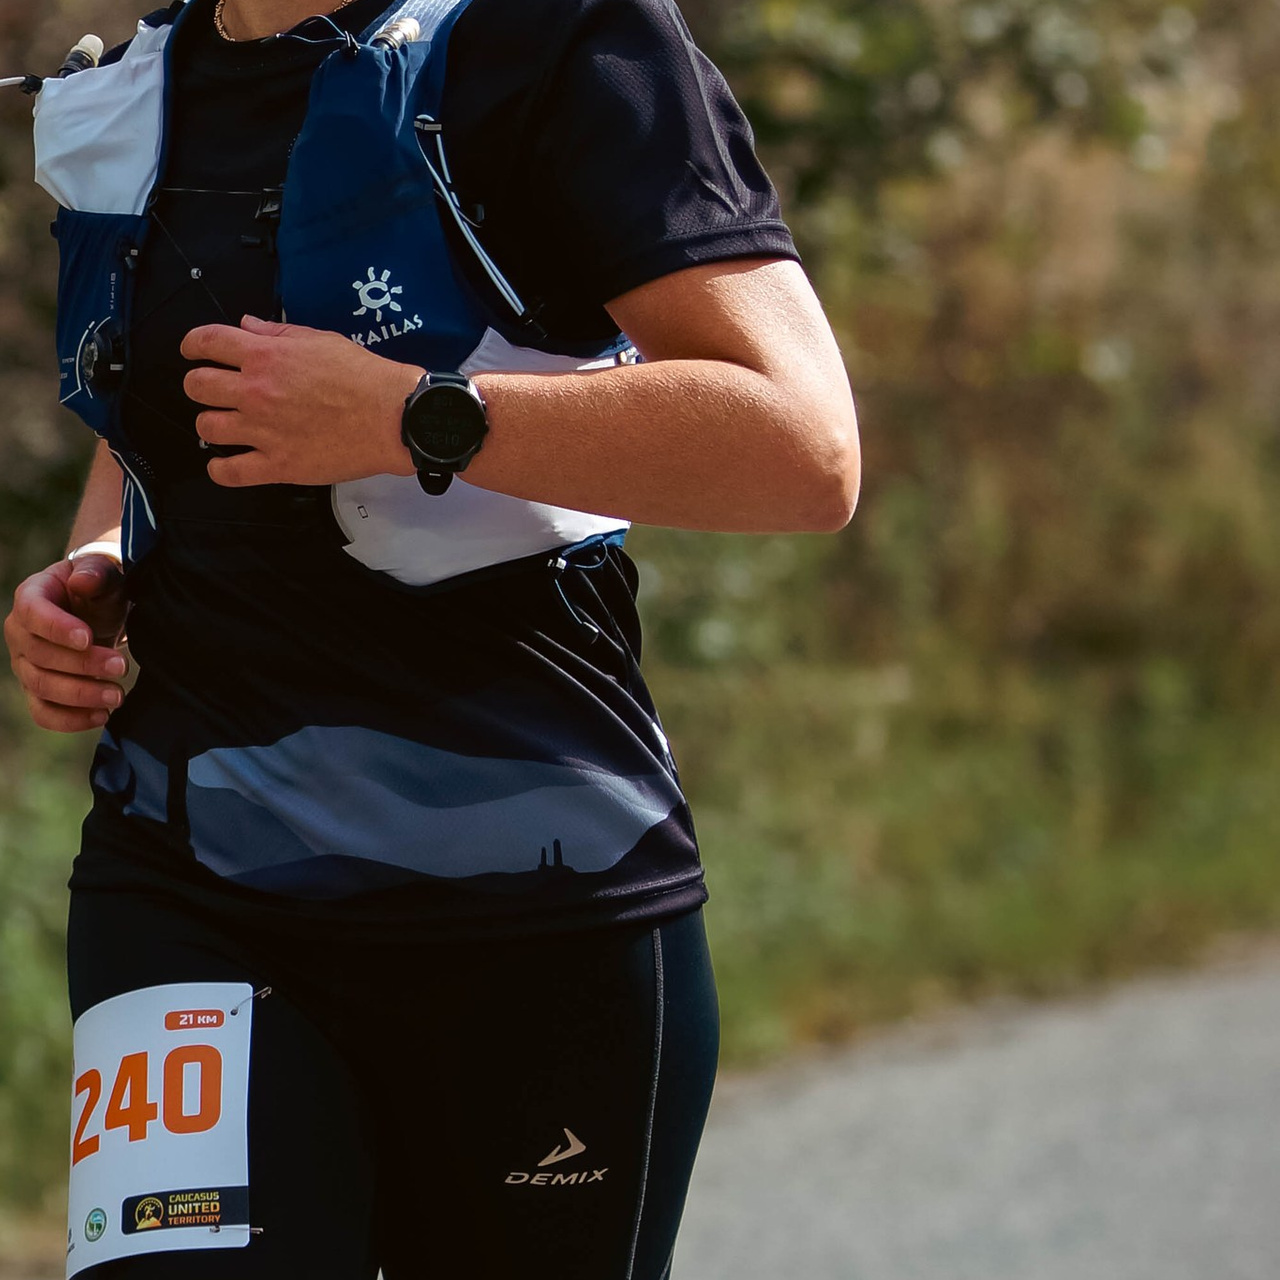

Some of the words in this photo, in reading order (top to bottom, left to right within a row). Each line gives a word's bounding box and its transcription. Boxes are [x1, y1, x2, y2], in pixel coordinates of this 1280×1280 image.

[351, 314, 423, 347] KAILAS
[179, 1013, 194, 1025] 21
[73, 1044, 222, 1167] 240
[504, 1167, 609, 1186] DEMIX
[169, 1191, 220, 1203] CAUCASUS
[168, 1201, 220, 1215] UNITED
[168, 1214, 221, 1226] TERRITORY
